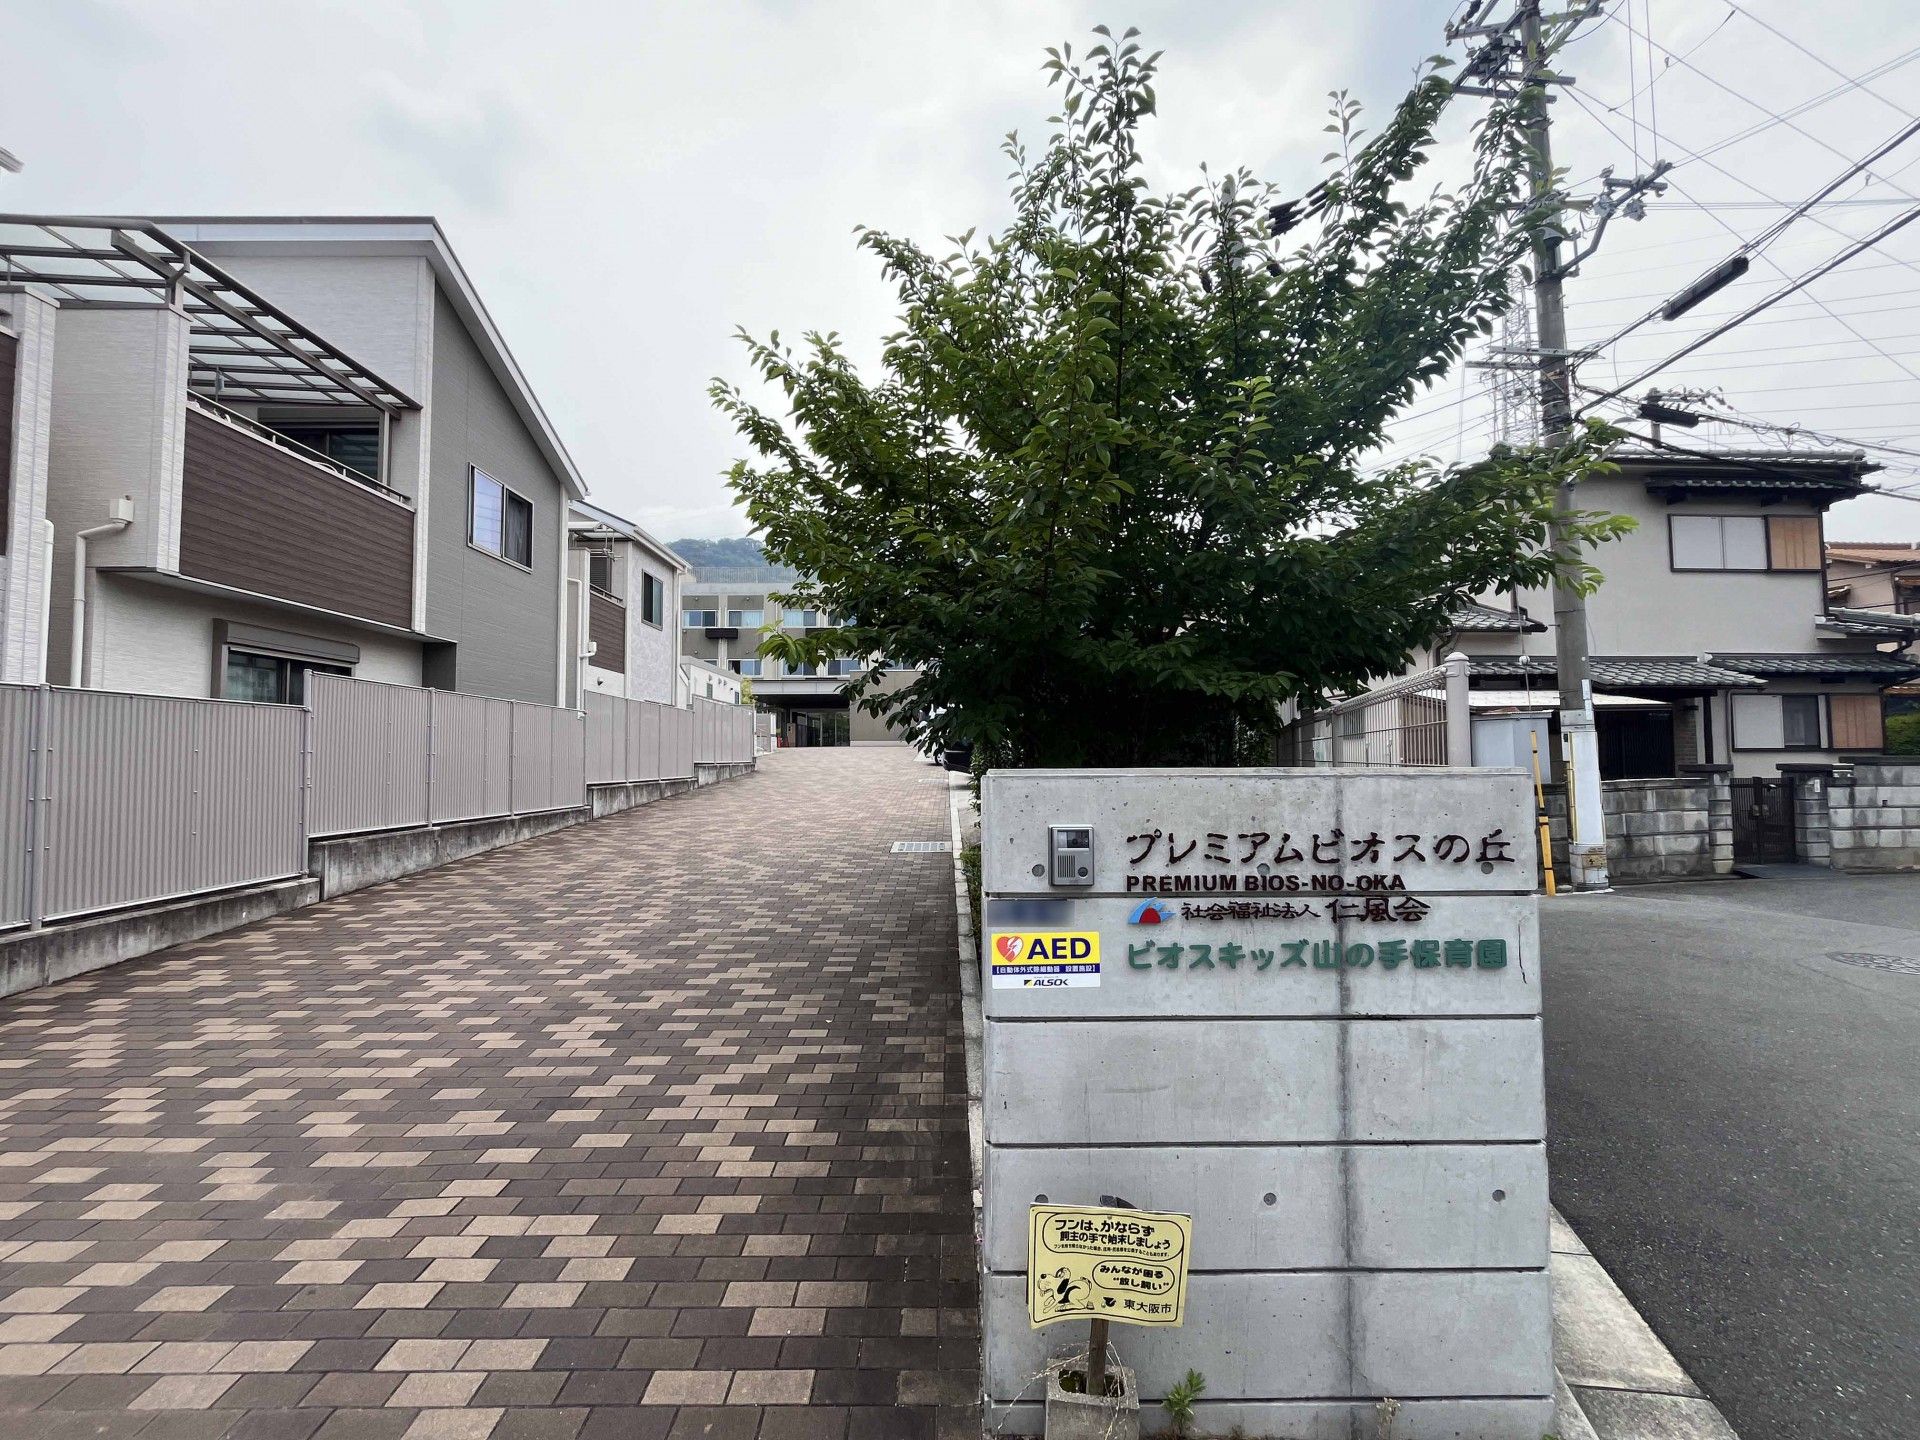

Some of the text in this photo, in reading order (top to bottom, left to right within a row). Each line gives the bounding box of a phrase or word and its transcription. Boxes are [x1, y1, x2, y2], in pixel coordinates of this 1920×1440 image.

[1126, 828, 1515, 864] プレミアムビオスの丘
[1126, 874, 1406, 892] PREMIUM BIOS-NO-OKA
[1181, 896, 1431, 924] 社会福祉法人 仁風会
[1026, 937, 1092, 960] AED
[1128, 938, 1508, 971] ビオスキッズ山の手保育園
[1033, 978, 1069, 987] ALSOK
[1055, 1219, 1155, 1237] フンは、かならず
[1060, 1230, 1171, 1250] 飼主の手で始末しましょう
[1100, 1265, 1164, 1279] みんなが困る
[1123, 1298, 1172, 1314] 東大阪市
